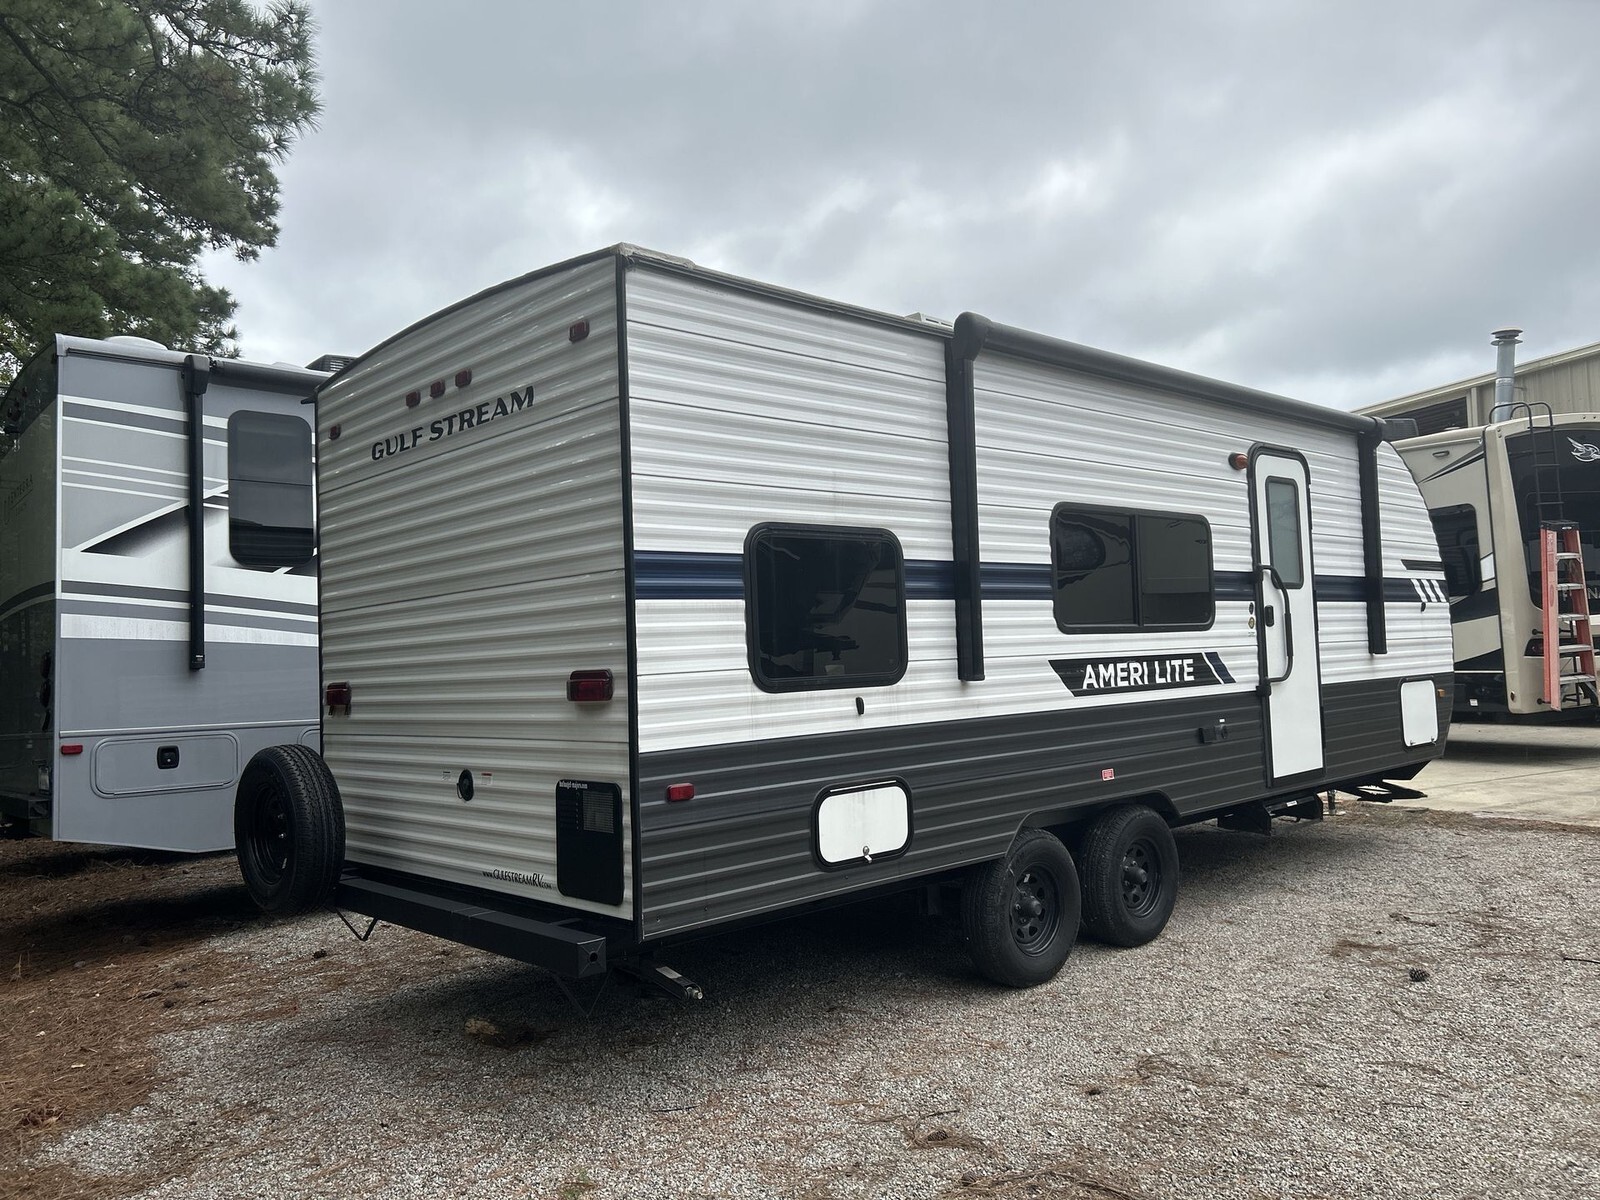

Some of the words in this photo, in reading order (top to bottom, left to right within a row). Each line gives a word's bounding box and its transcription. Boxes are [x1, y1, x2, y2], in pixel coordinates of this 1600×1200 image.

[371, 426, 424, 461] GULF
[429, 385, 535, 442] STREAM
[1082, 661, 1149, 690] AMERI
[1154, 658, 1195, 684] LITE
